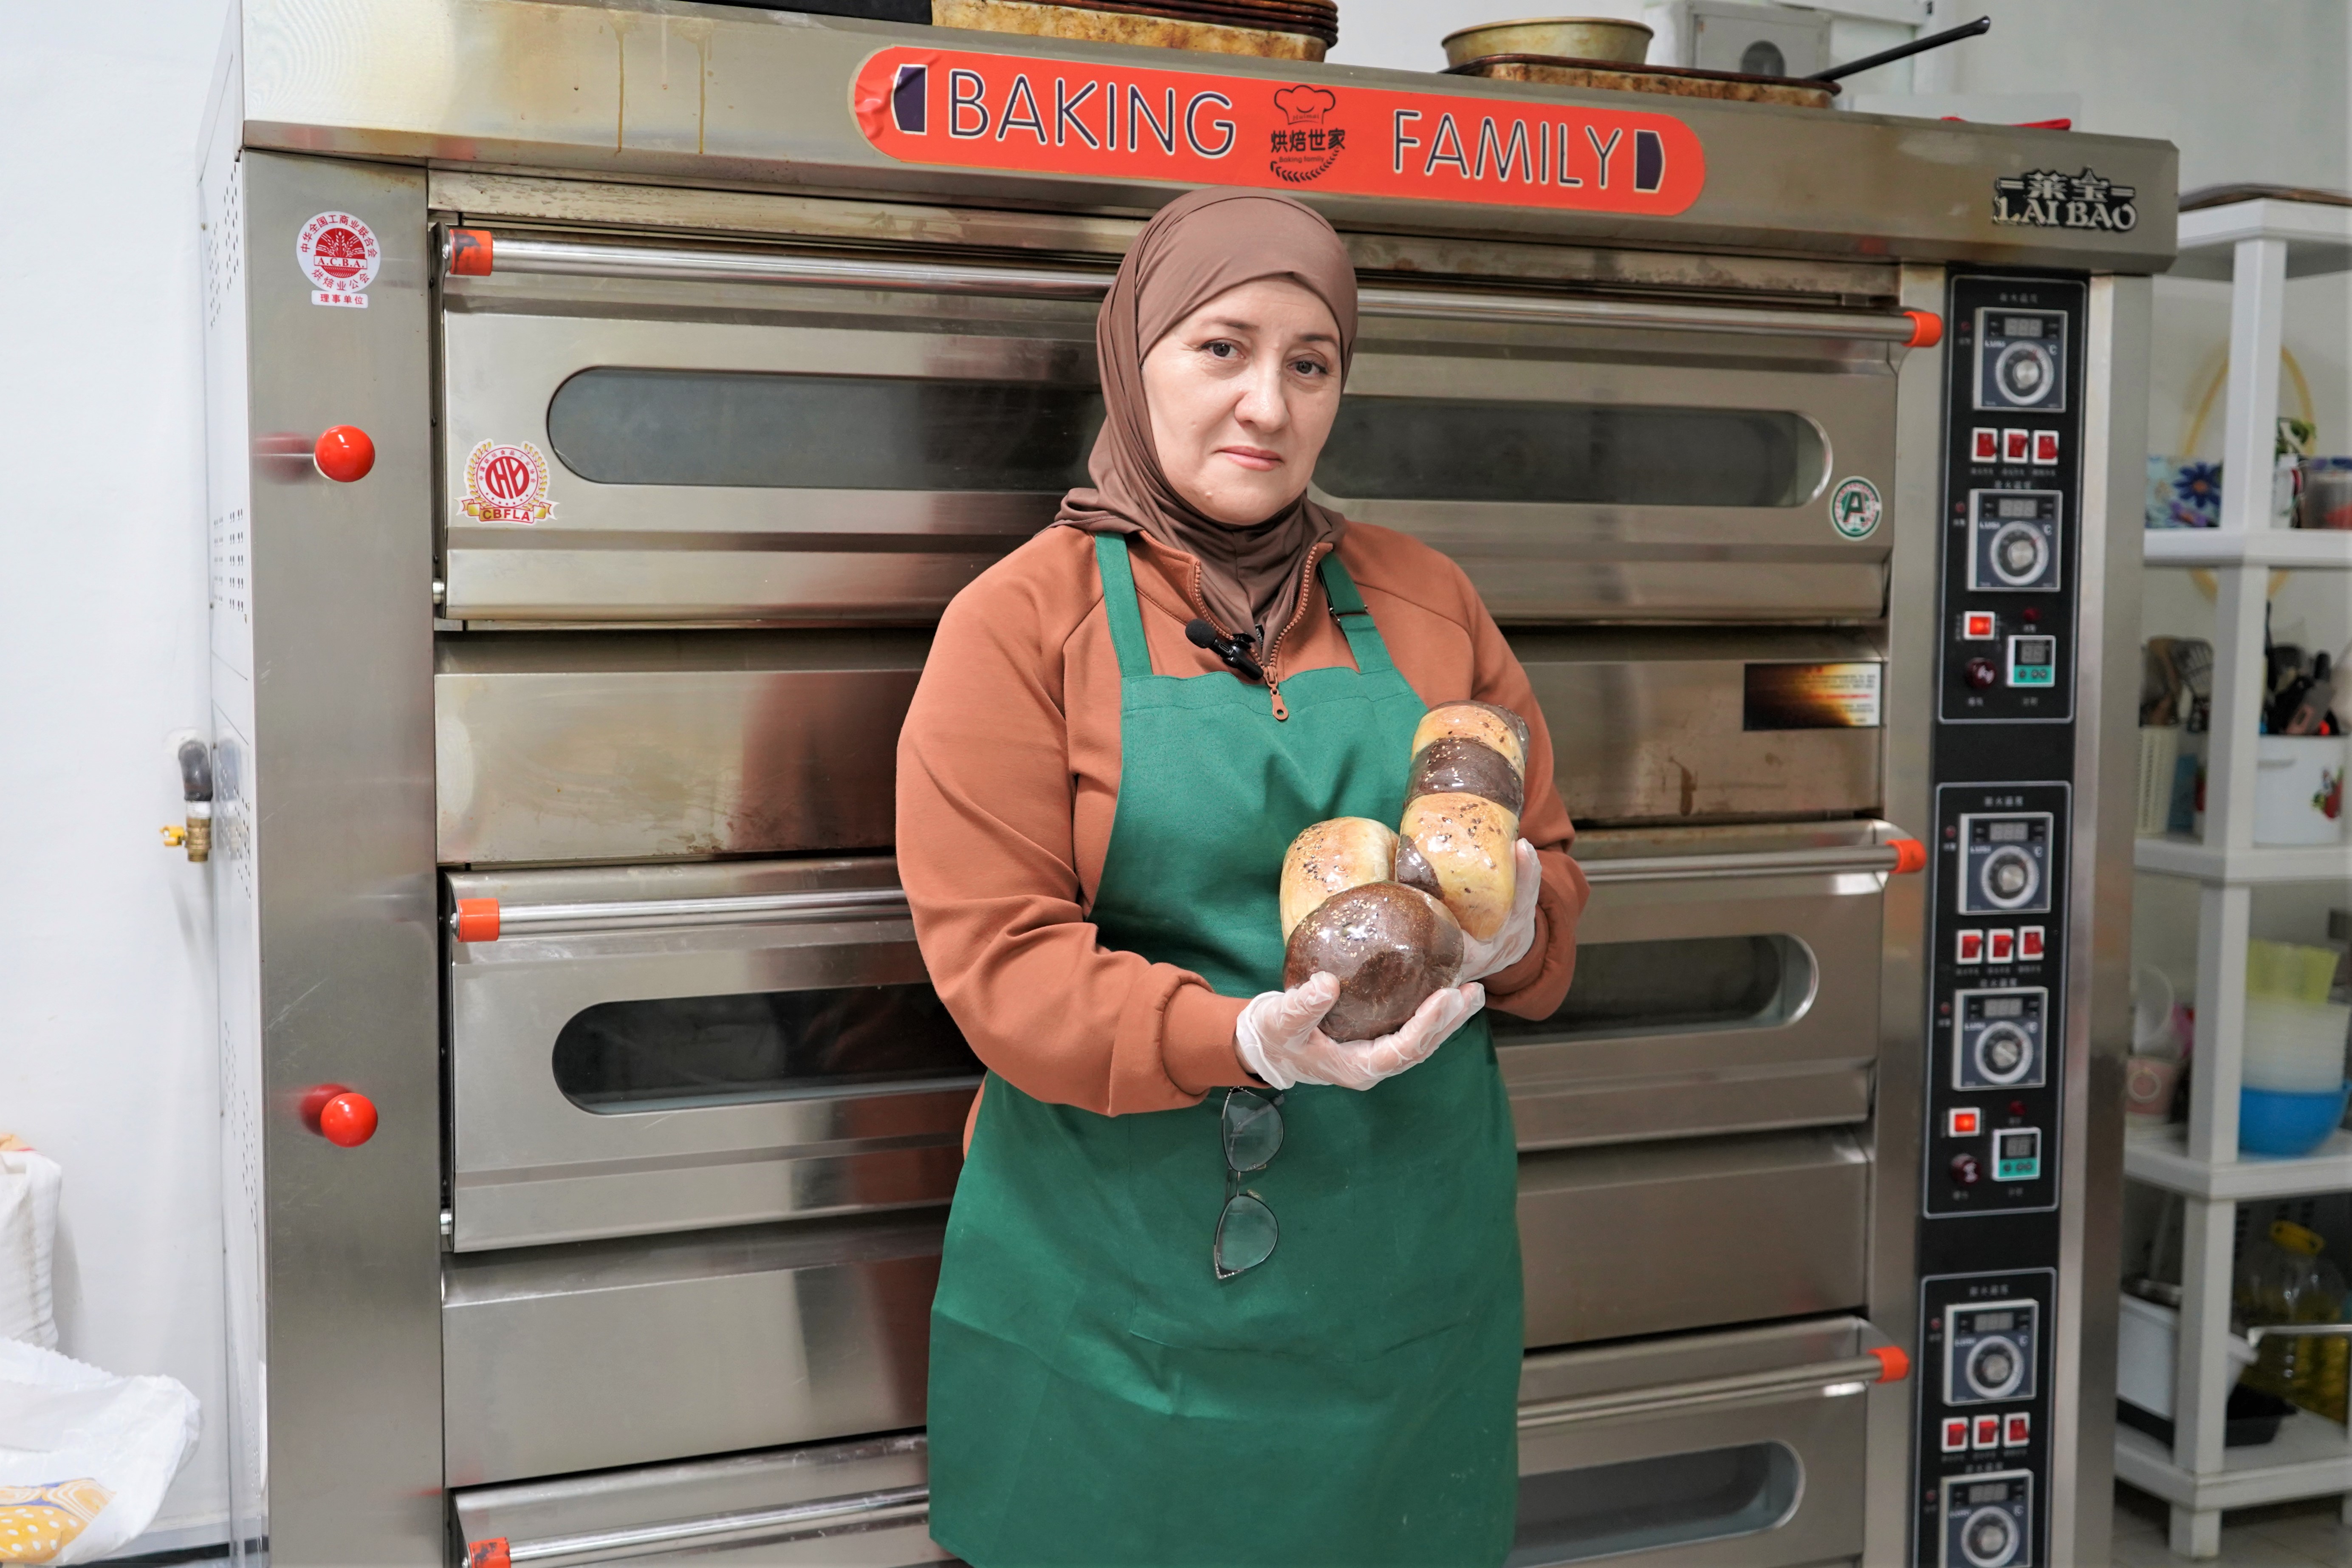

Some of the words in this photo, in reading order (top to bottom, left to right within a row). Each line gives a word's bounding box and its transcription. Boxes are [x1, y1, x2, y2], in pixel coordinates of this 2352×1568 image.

[949, 68, 1236, 159] BAKING
[1393, 108, 1622, 189] FAMILY
[1271, 128, 1345, 153] 烘焙世家
[300, 215, 378, 258] 中华全国工商业联合会
[318, 257, 364, 268] A.C.B.A.
[312, 268, 370, 291] 烘焙业公会
[320, 294, 364, 305] 理事单位
[483, 509, 530, 521] CBFLA
